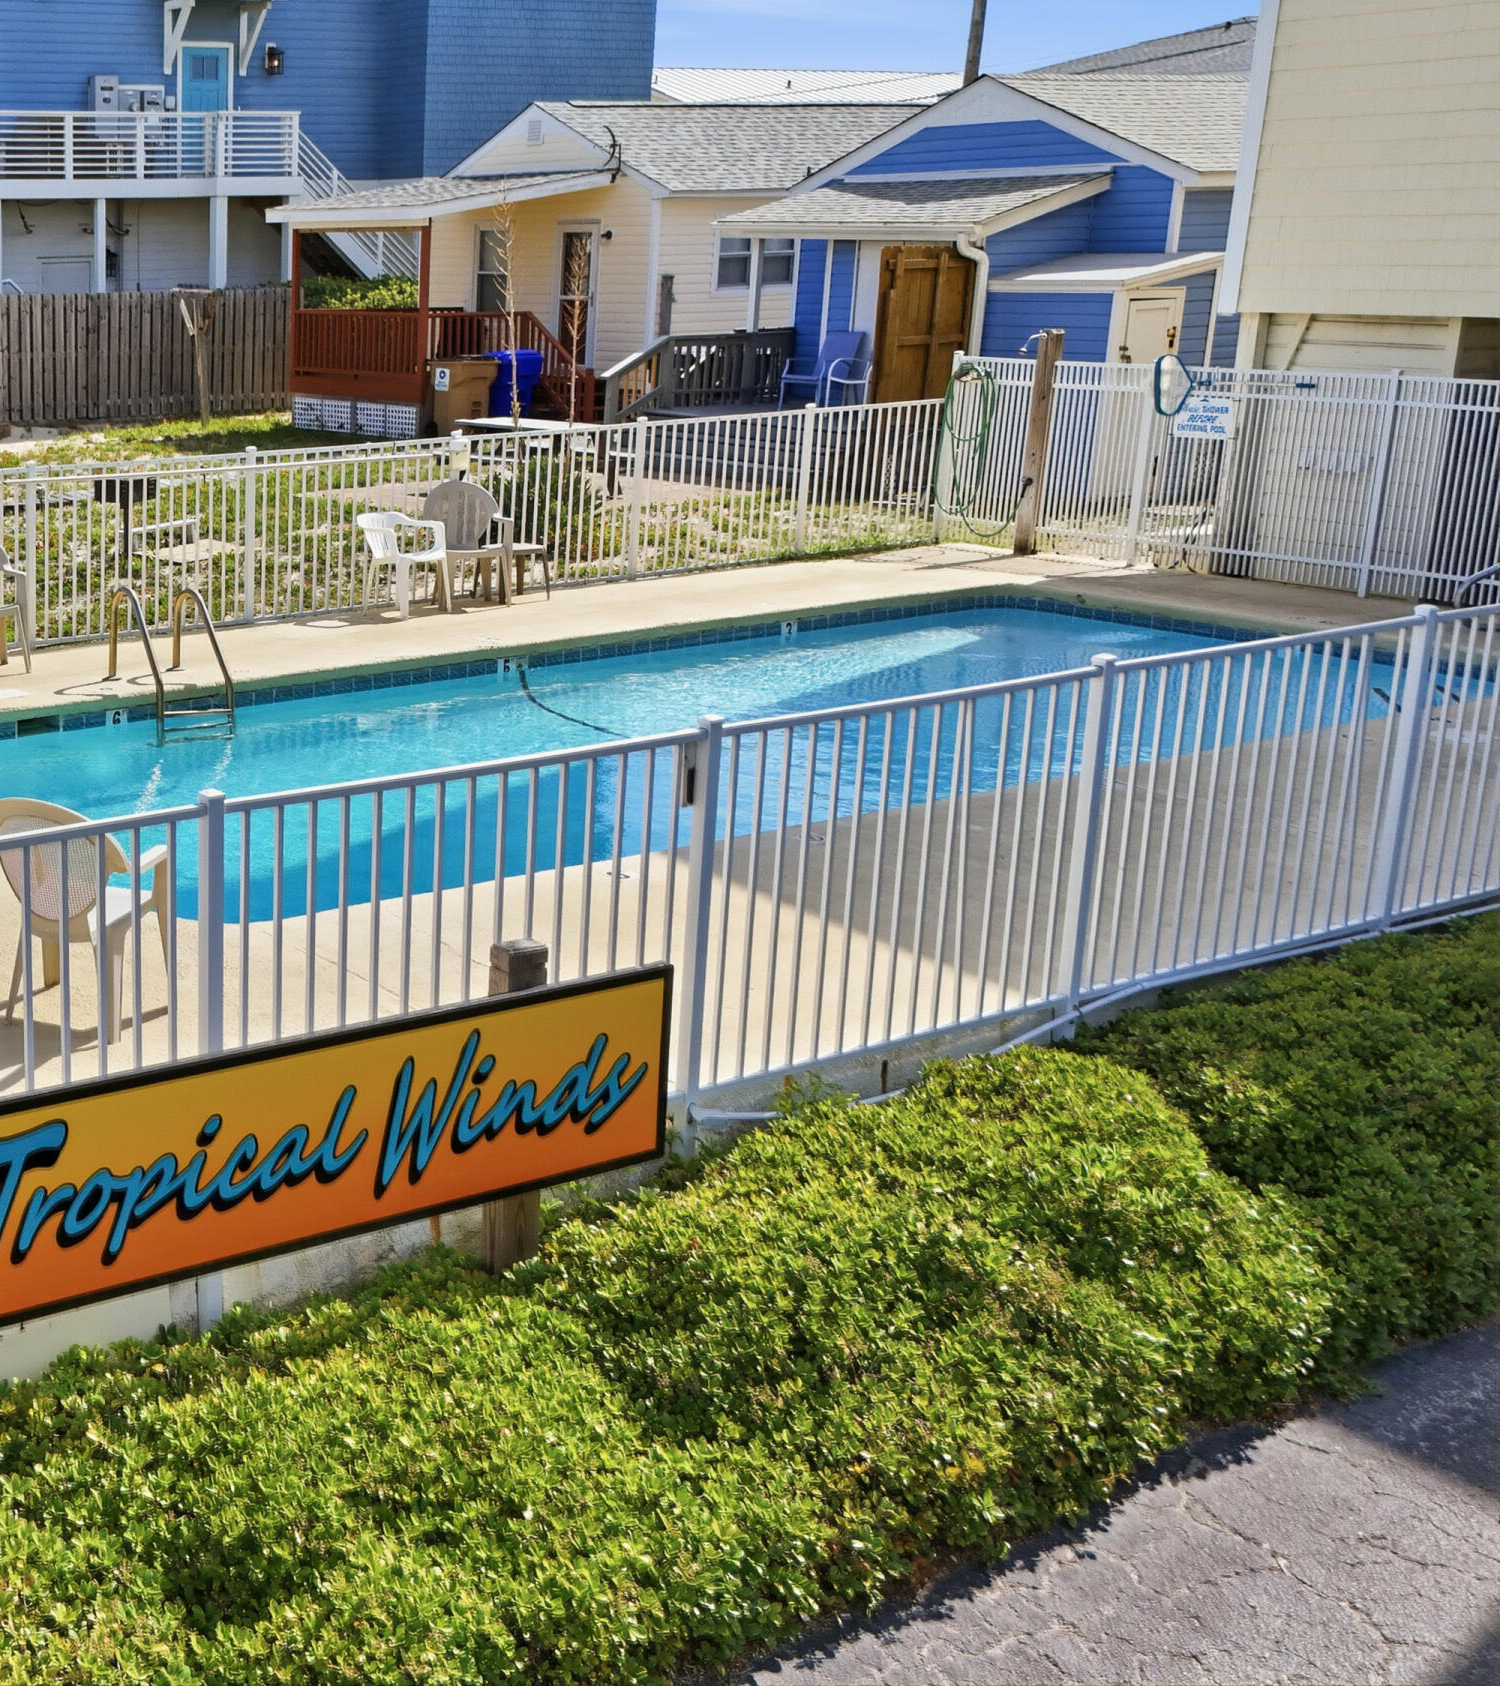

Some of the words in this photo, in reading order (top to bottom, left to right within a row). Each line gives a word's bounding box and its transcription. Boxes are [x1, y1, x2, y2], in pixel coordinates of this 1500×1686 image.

[1202, 406, 1229, 414] SHOWER
[1187, 414, 1219, 423] BEFORE
[1177, 424, 1207, 432] ENTERING
[1210, 425, 1226, 433] POOL
[112, 711, 121, 725] 6
[374, 1028, 648, 1200] Winds
